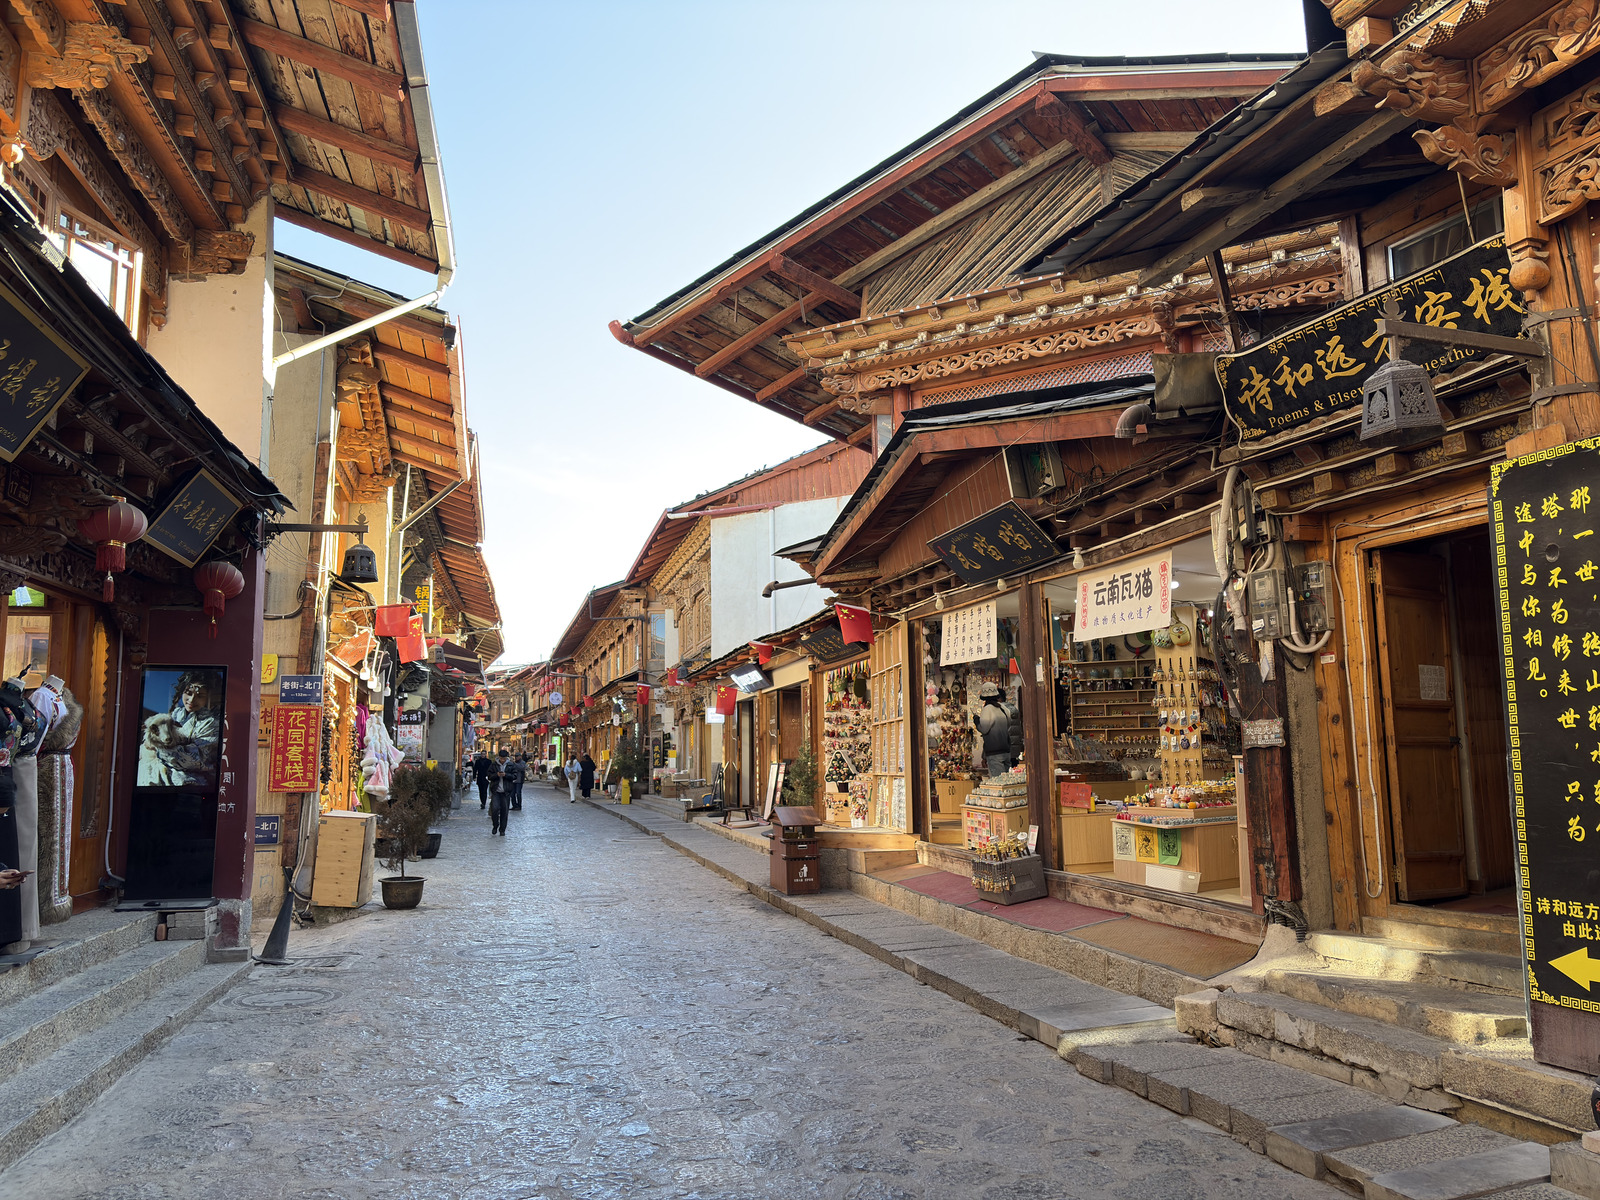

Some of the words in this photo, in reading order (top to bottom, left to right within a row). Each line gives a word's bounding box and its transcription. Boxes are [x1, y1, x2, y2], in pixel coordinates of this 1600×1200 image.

[1238, 268, 1526, 414] 诗和远方客栈
[1268, 407, 1310, 428] Poems
[1313, 400, 1325, 411] &
[1328, 386, 1364, 407] Elsew
[1094, 568, 1153, 606] 云南瓦猫
[1514, 502, 1548, 698] 途中与你相见。
[1093, 605, 1153, 627] 非物质文化遗产
[261, 663, 275, 676] 厅
[284, 710, 307, 781] 花园客栈
[1245, 725, 1280, 736] 欢迎光临
[1535, 897, 1600, 921] 诗和远方
